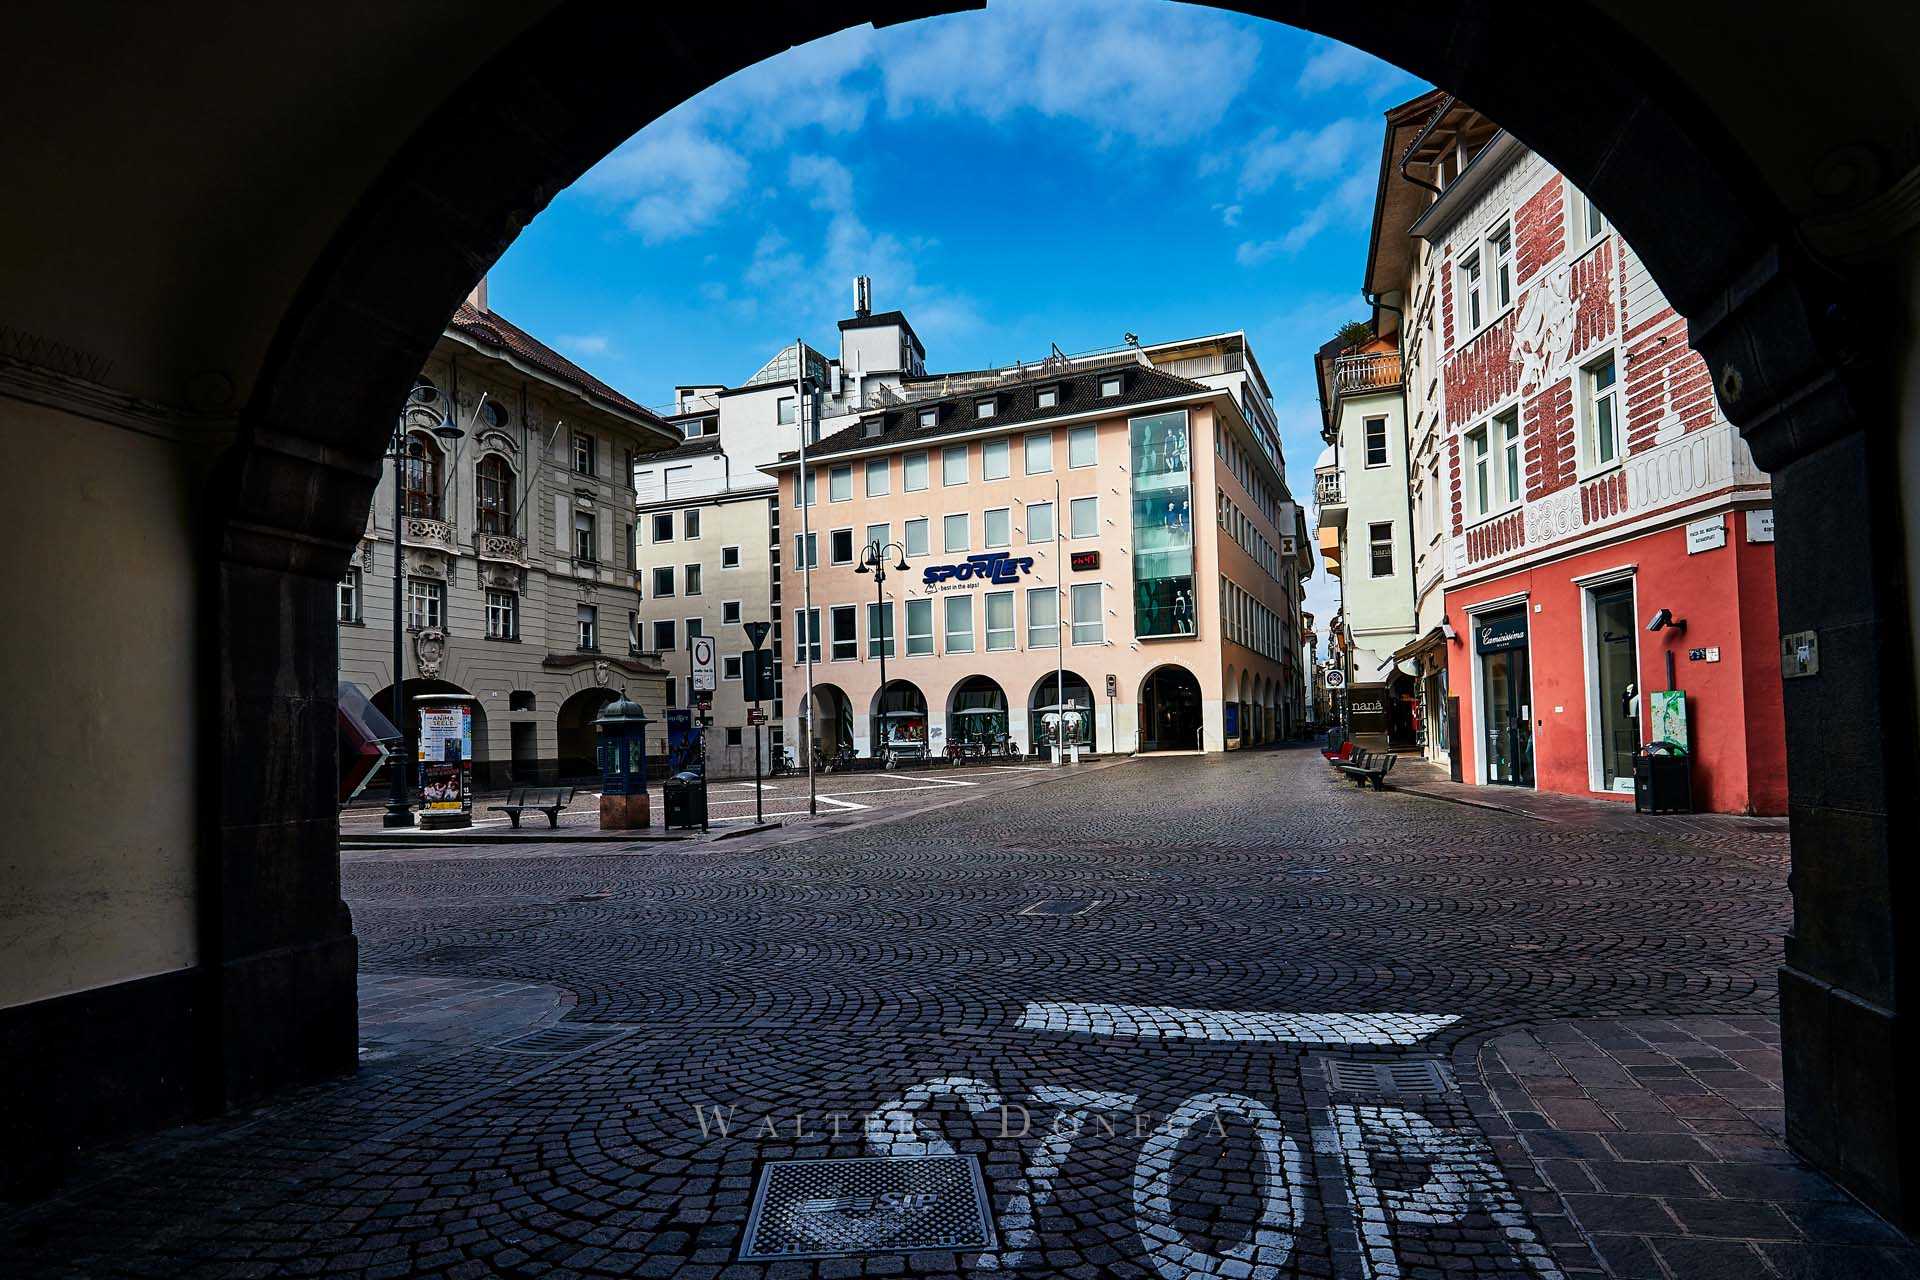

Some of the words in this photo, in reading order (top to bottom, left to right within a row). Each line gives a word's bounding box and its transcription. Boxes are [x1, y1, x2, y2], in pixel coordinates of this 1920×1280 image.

[923, 552, 1034, 584] SPORTLER
[1351, 700, 1384, 711] nanà
[879, 1191, 941, 1209] SIP
